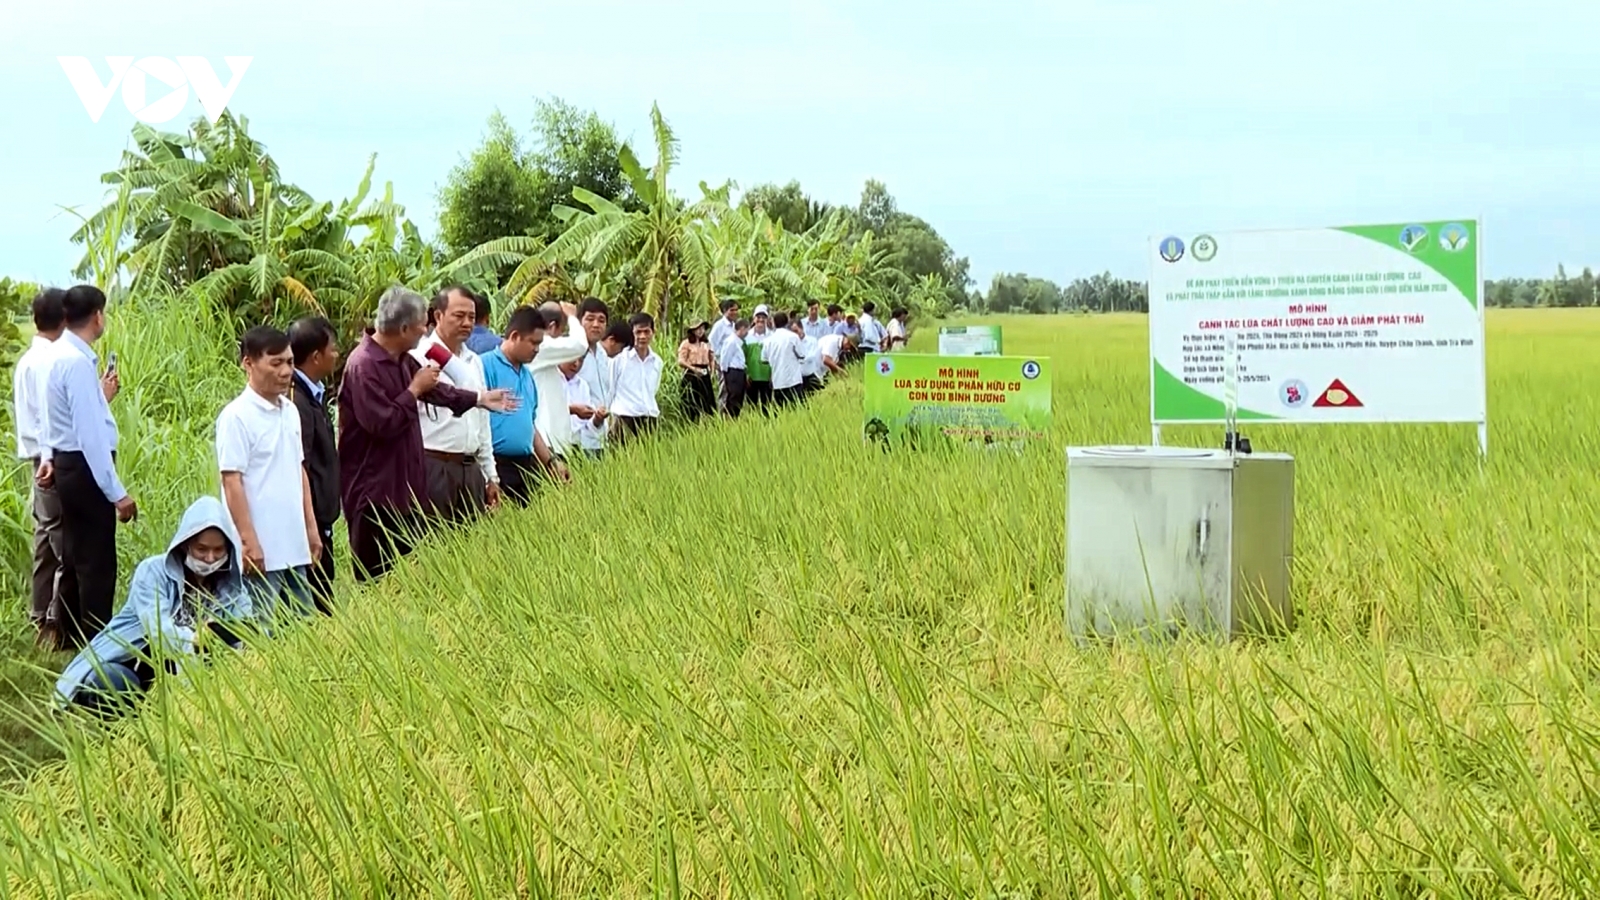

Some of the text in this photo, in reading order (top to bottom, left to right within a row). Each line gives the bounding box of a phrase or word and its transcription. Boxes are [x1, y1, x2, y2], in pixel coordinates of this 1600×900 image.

[1289, 303, 1327, 313] MÔ HÌNH
[1199, 320, 1222, 330] CANH
[1286, 317, 1314, 328] LƯỢNG
[1317, 317, 1334, 327] CAO
[1336, 315, 1348, 326] VÀ
[939, 367, 979, 378] MÔ HÌNH
[914, 376, 928, 389] SỬ
[930, 379, 955, 391] DỤNG
[1007, 381, 1021, 391] CƠ
[909, 391, 1005, 403] CON VOI BÌNH DƯƠNG
